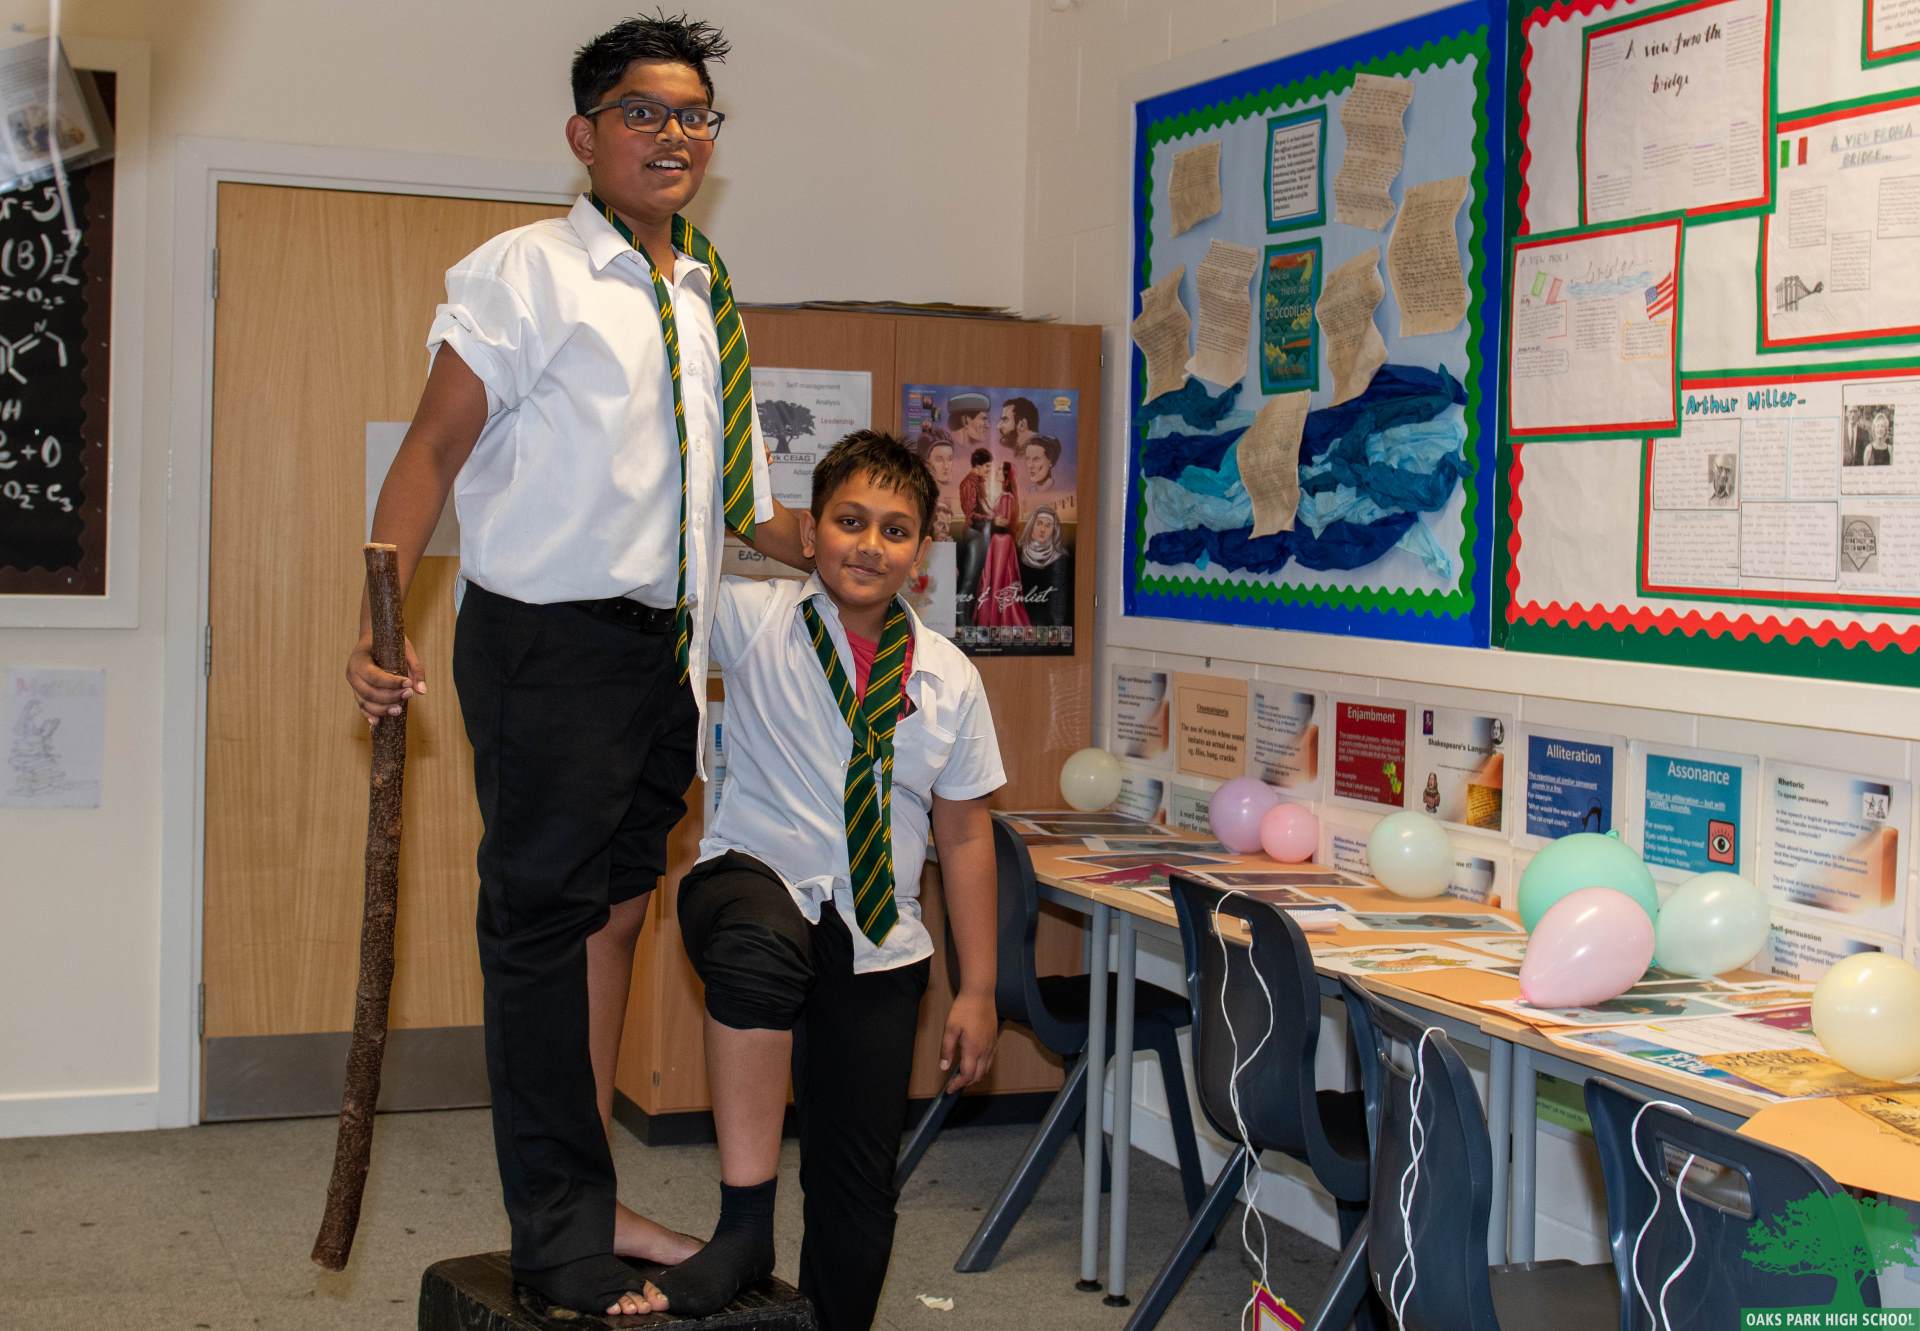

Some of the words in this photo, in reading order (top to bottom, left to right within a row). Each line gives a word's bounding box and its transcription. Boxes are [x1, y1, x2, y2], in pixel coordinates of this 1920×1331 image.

[1265, 304, 1312, 321] CROCODILES
[1347, 706, 1396, 725] Enjambment
[1427, 738, 1466, 752] Shakespeare's
[1546, 744, 1601, 765] Alliteration
[1667, 760, 1730, 786] Assonance
[1777, 777, 1805, 790] Rhetoric
